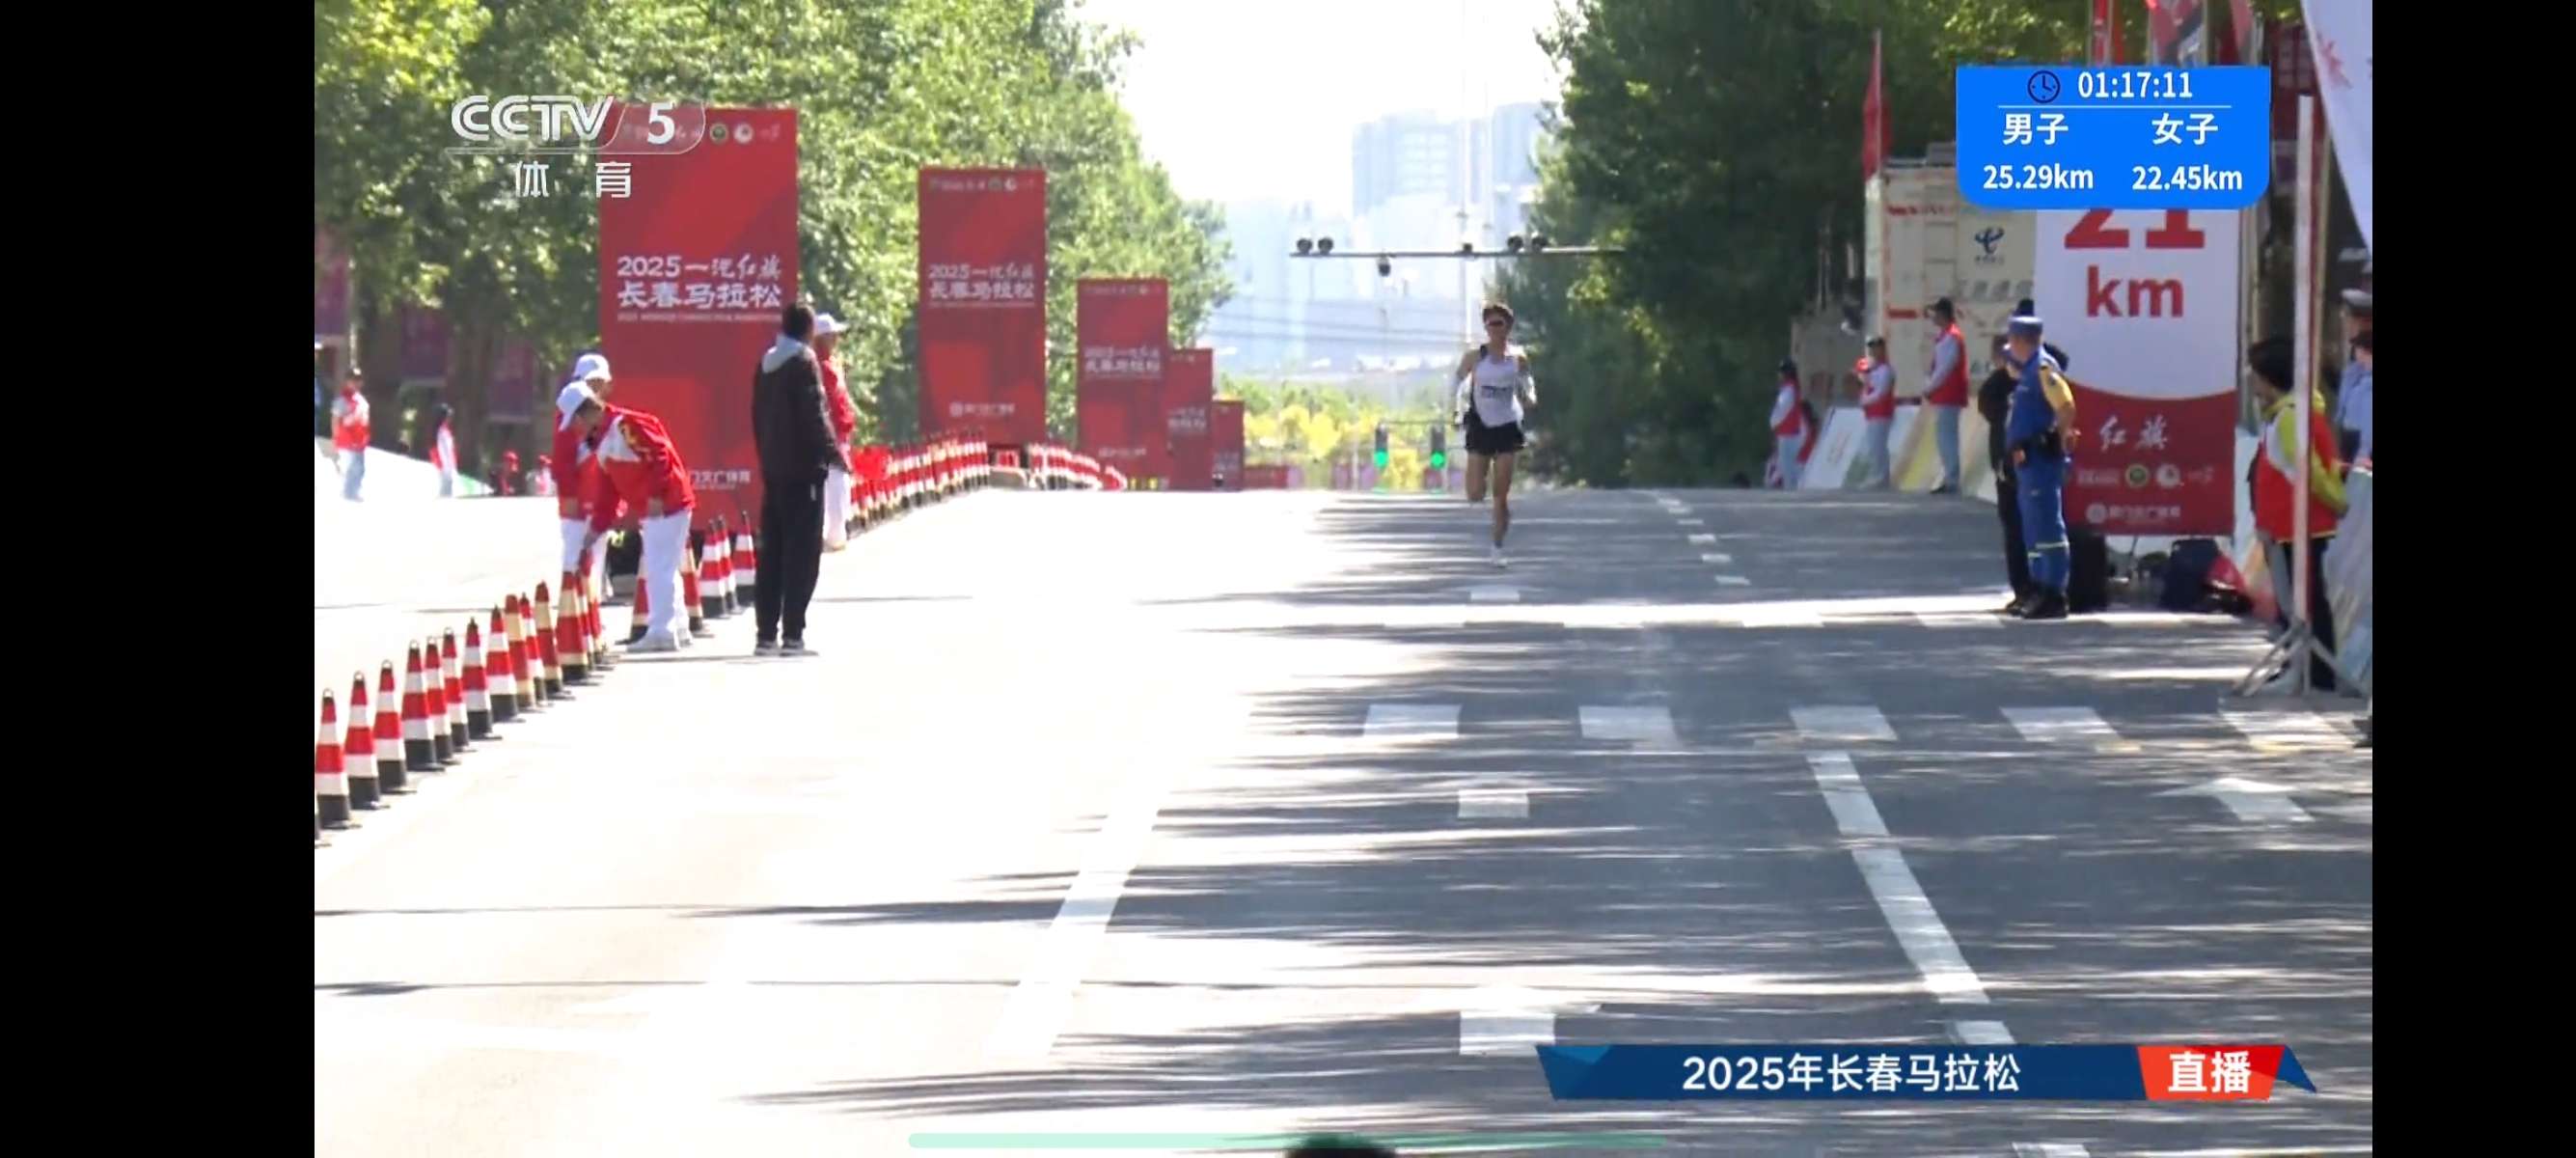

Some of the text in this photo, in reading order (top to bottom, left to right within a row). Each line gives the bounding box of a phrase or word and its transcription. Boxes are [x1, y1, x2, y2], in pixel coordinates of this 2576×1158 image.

[617, 281, 781, 309] 长春马拉松
[2088, 265, 2184, 317] km
